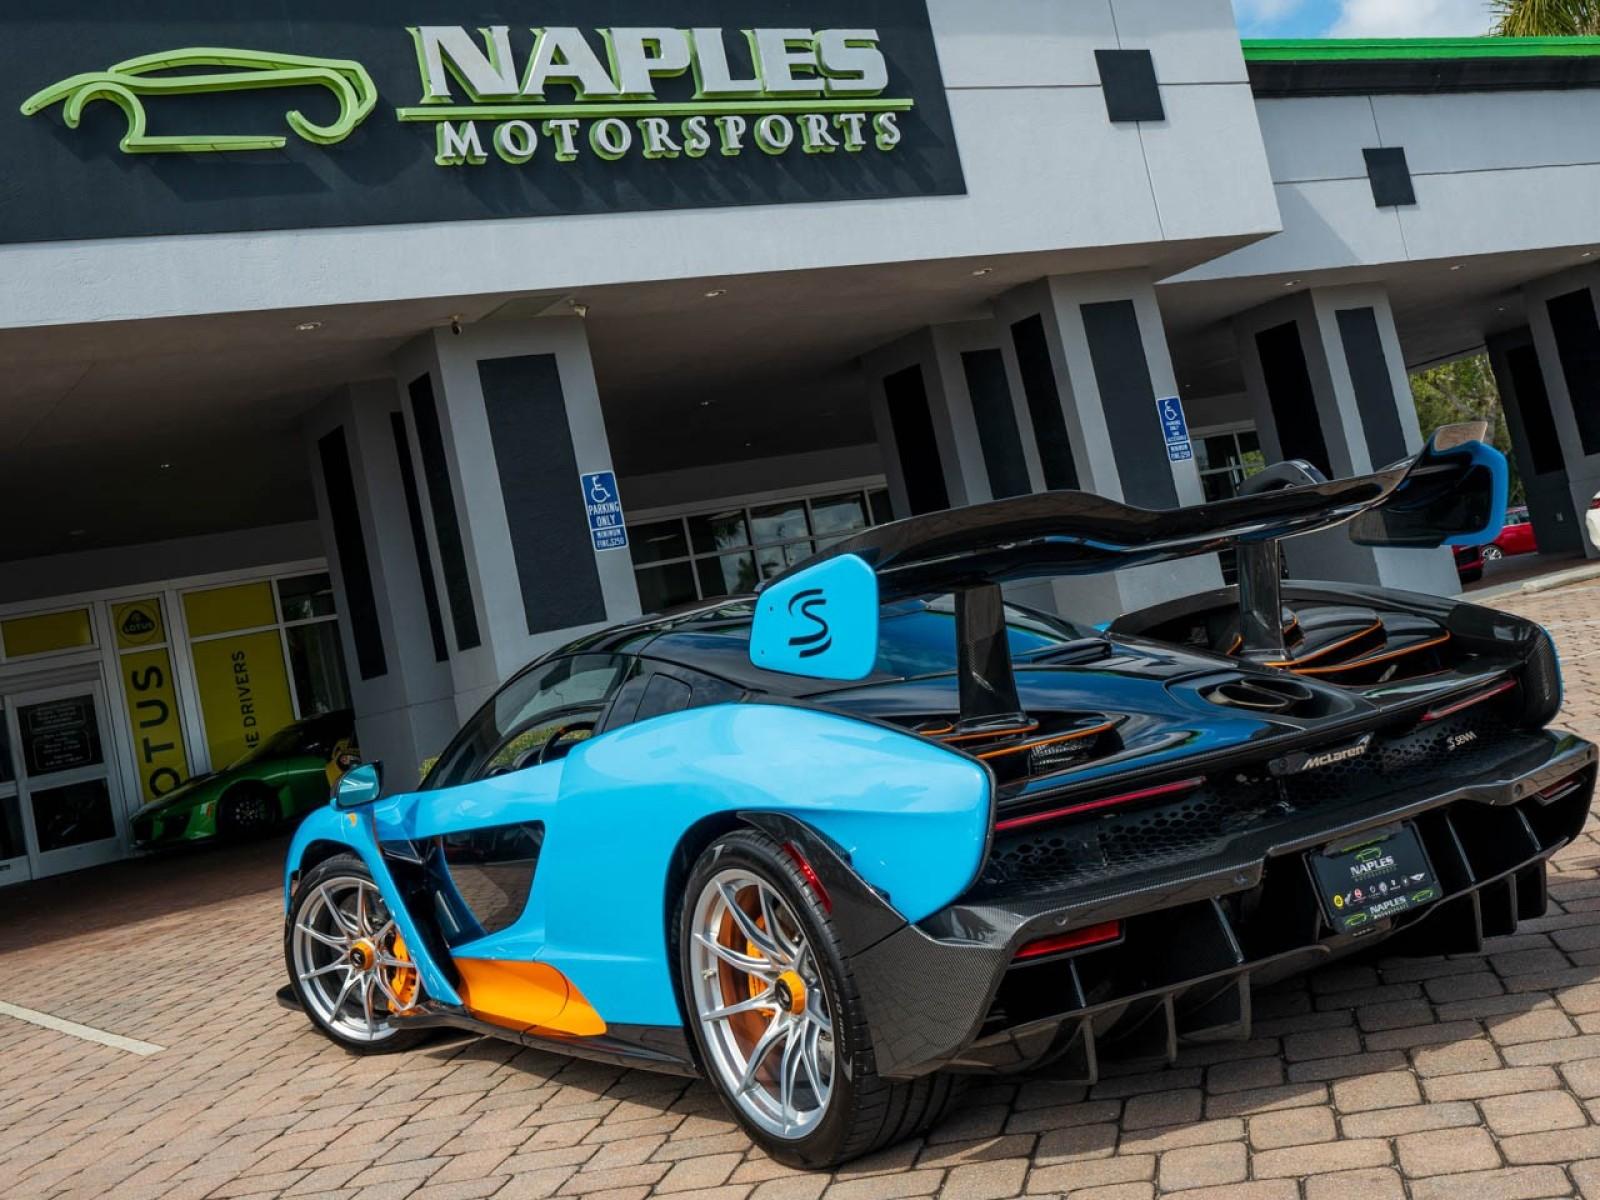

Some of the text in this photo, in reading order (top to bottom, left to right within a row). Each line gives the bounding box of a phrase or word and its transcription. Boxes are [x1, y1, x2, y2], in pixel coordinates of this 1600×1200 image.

[405, 26, 889, 103] NAPLES
[435, 111, 901, 166] MOTORSPORTS
[588, 501, 620, 516] PARKING
[596, 514, 616, 527] ONLY
[232, 650, 257, 728] DRIVERS
[131, 665, 181, 798] OTUS
[1302, 745, 1366, 770] McLaren
[1350, 855, 1394, 876] NAPLES
[1369, 895, 1406, 914] NAPLES
